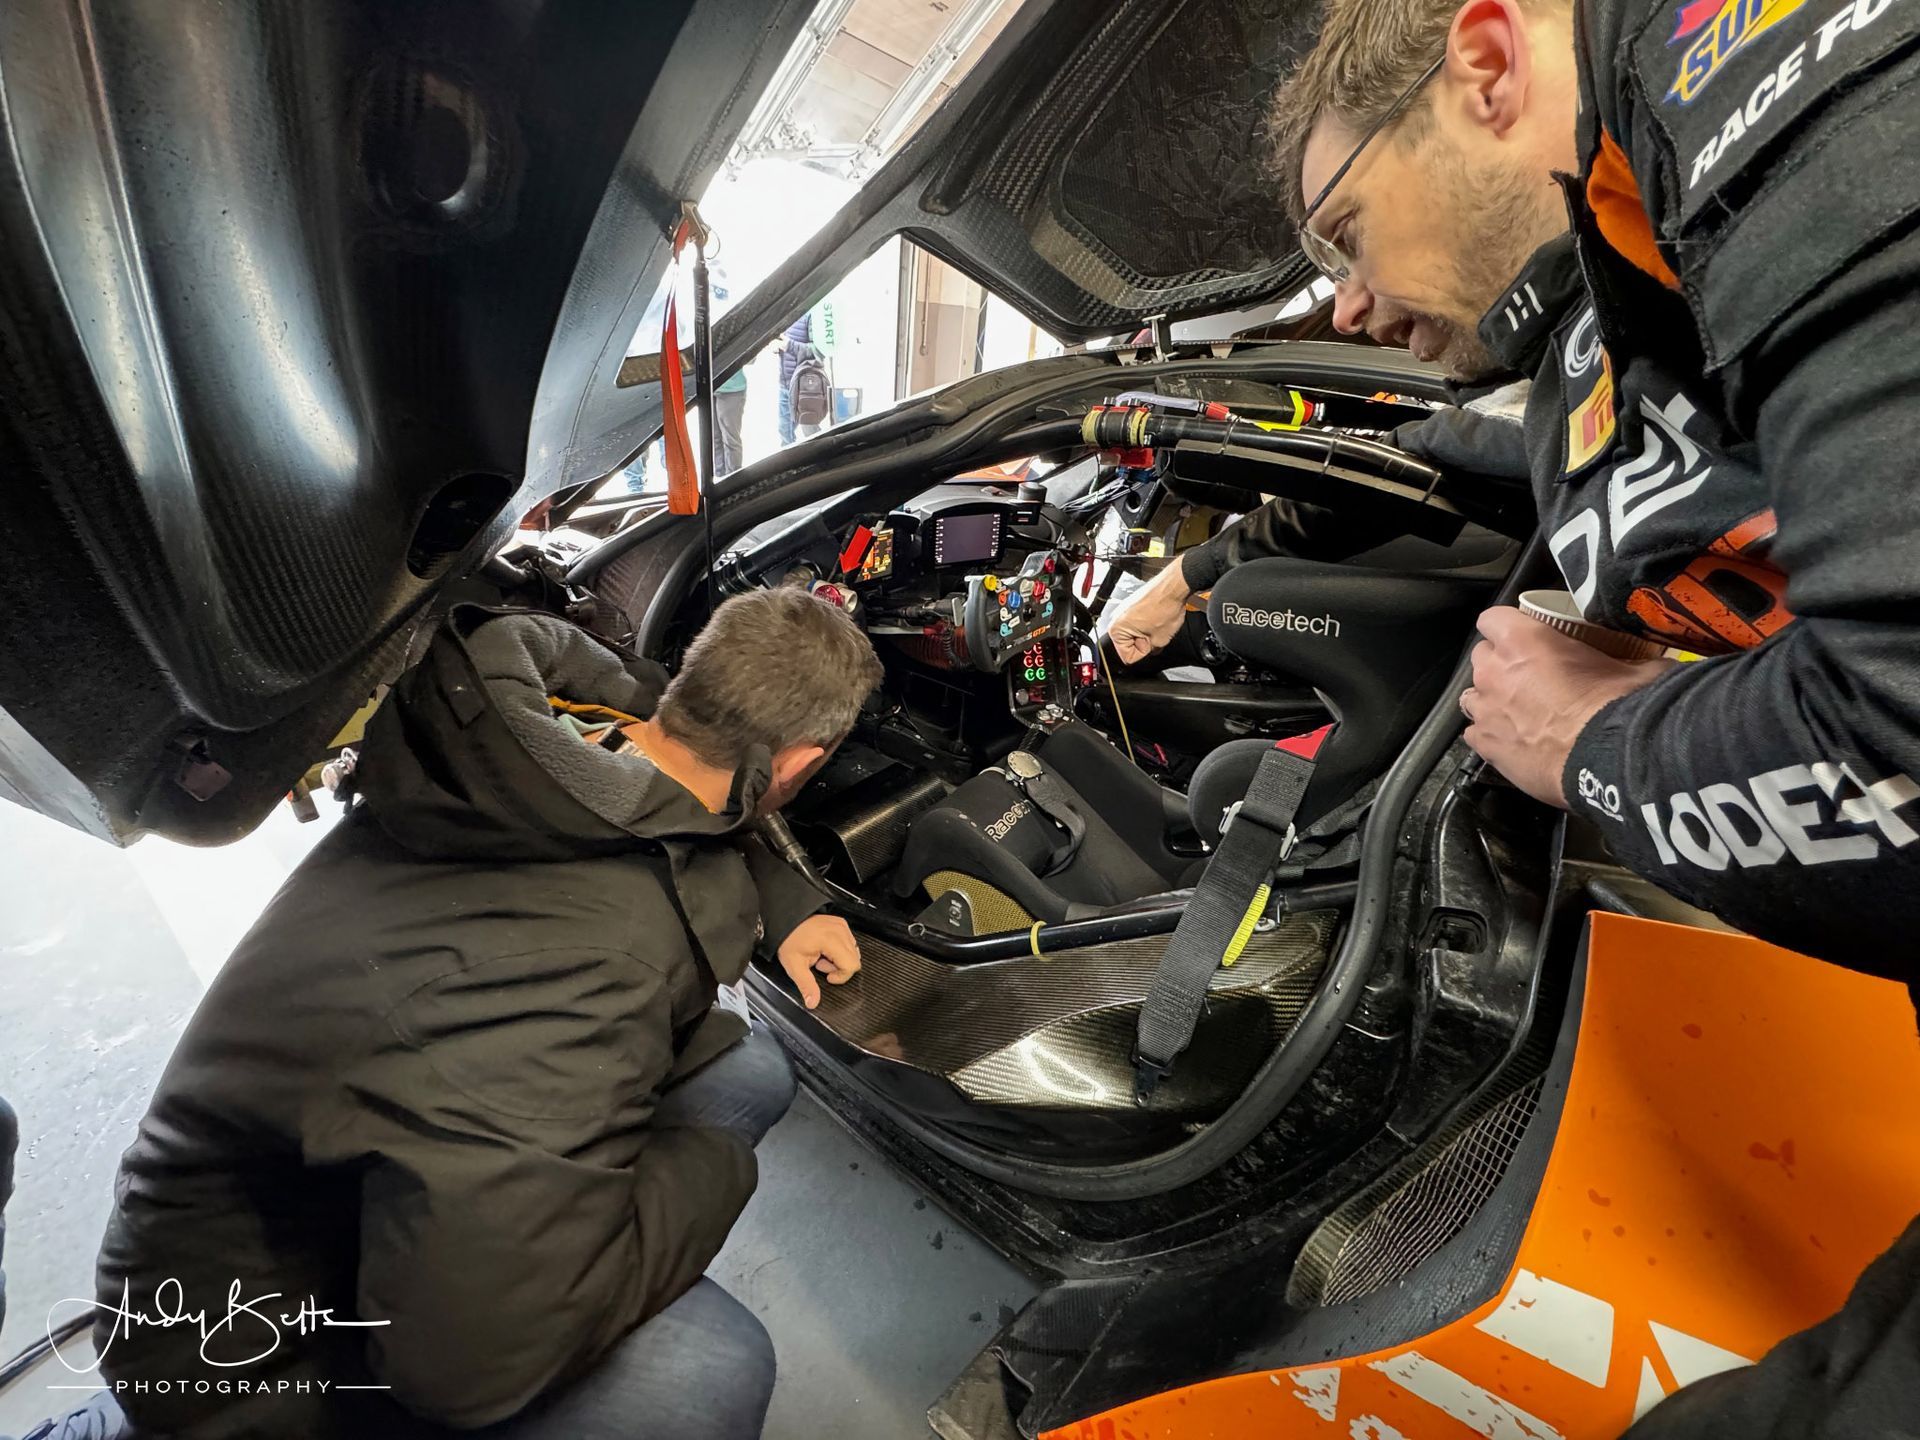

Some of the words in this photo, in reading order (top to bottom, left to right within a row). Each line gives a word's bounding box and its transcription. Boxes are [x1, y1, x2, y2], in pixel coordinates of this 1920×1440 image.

[1686, 0, 1778, 91] SU
[1689, 41, 1807, 189] RACE
[1813, 0, 1902, 62] FU
[823, 302, 835, 347] START
[1222, 602, 1341, 638] Racetech
